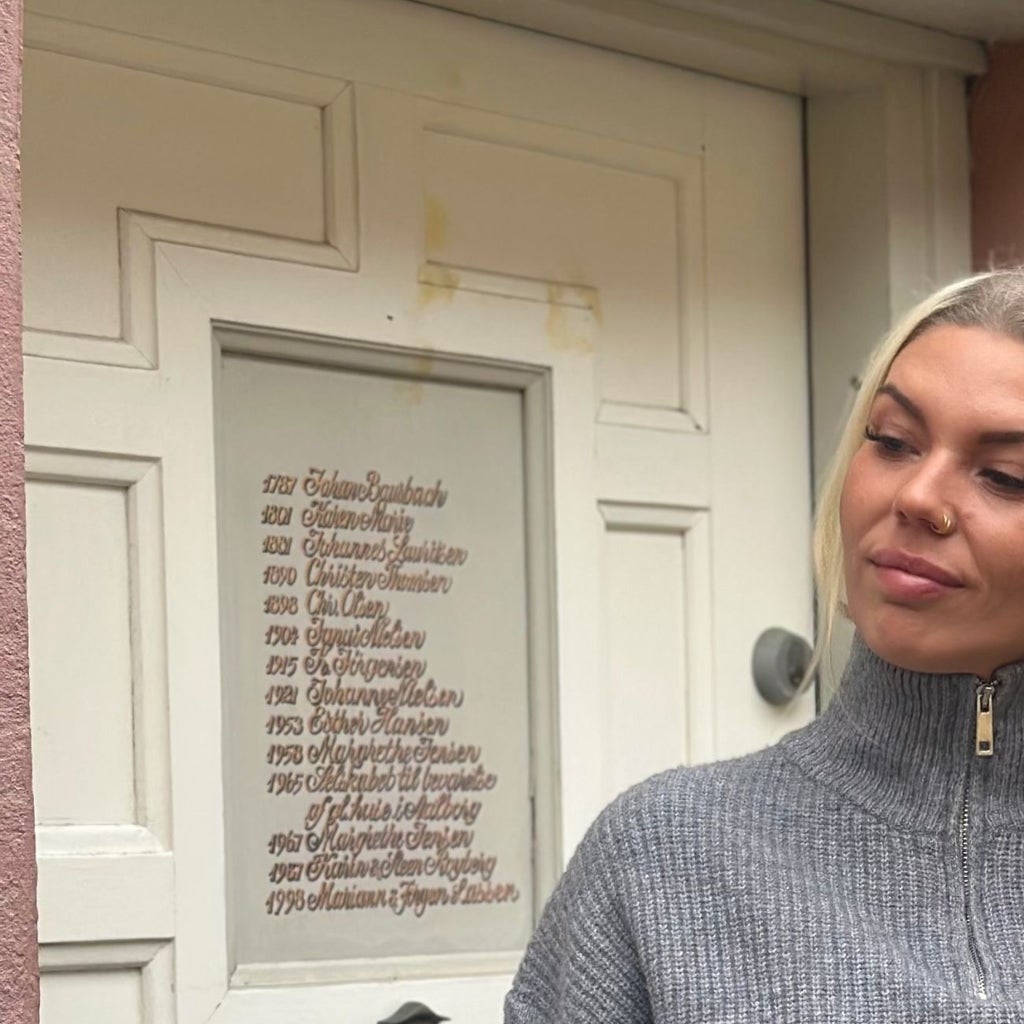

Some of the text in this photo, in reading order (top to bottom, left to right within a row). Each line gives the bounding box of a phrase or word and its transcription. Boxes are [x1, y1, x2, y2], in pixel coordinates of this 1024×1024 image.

[263, 474, 297, 495] 1787
[303, 529, 386, 561] Johannes
[264, 566, 297, 587] 1890
[264, 595, 298, 615] 1898
[342, 589, 389, 619] Olsen
[266, 656, 298, 676] 1915
[265, 685, 298, 705] 1921
[267, 707, 449, 736] 1953 Esther Hansen
[414, 738, 481, 764] Jensen
[267, 773, 303, 795] 1965
[398, 766, 420, 792] til
[268, 831, 303, 856] 1967
[406, 823, 475, 850] Jensen
[266, 890, 305, 915] 1998
